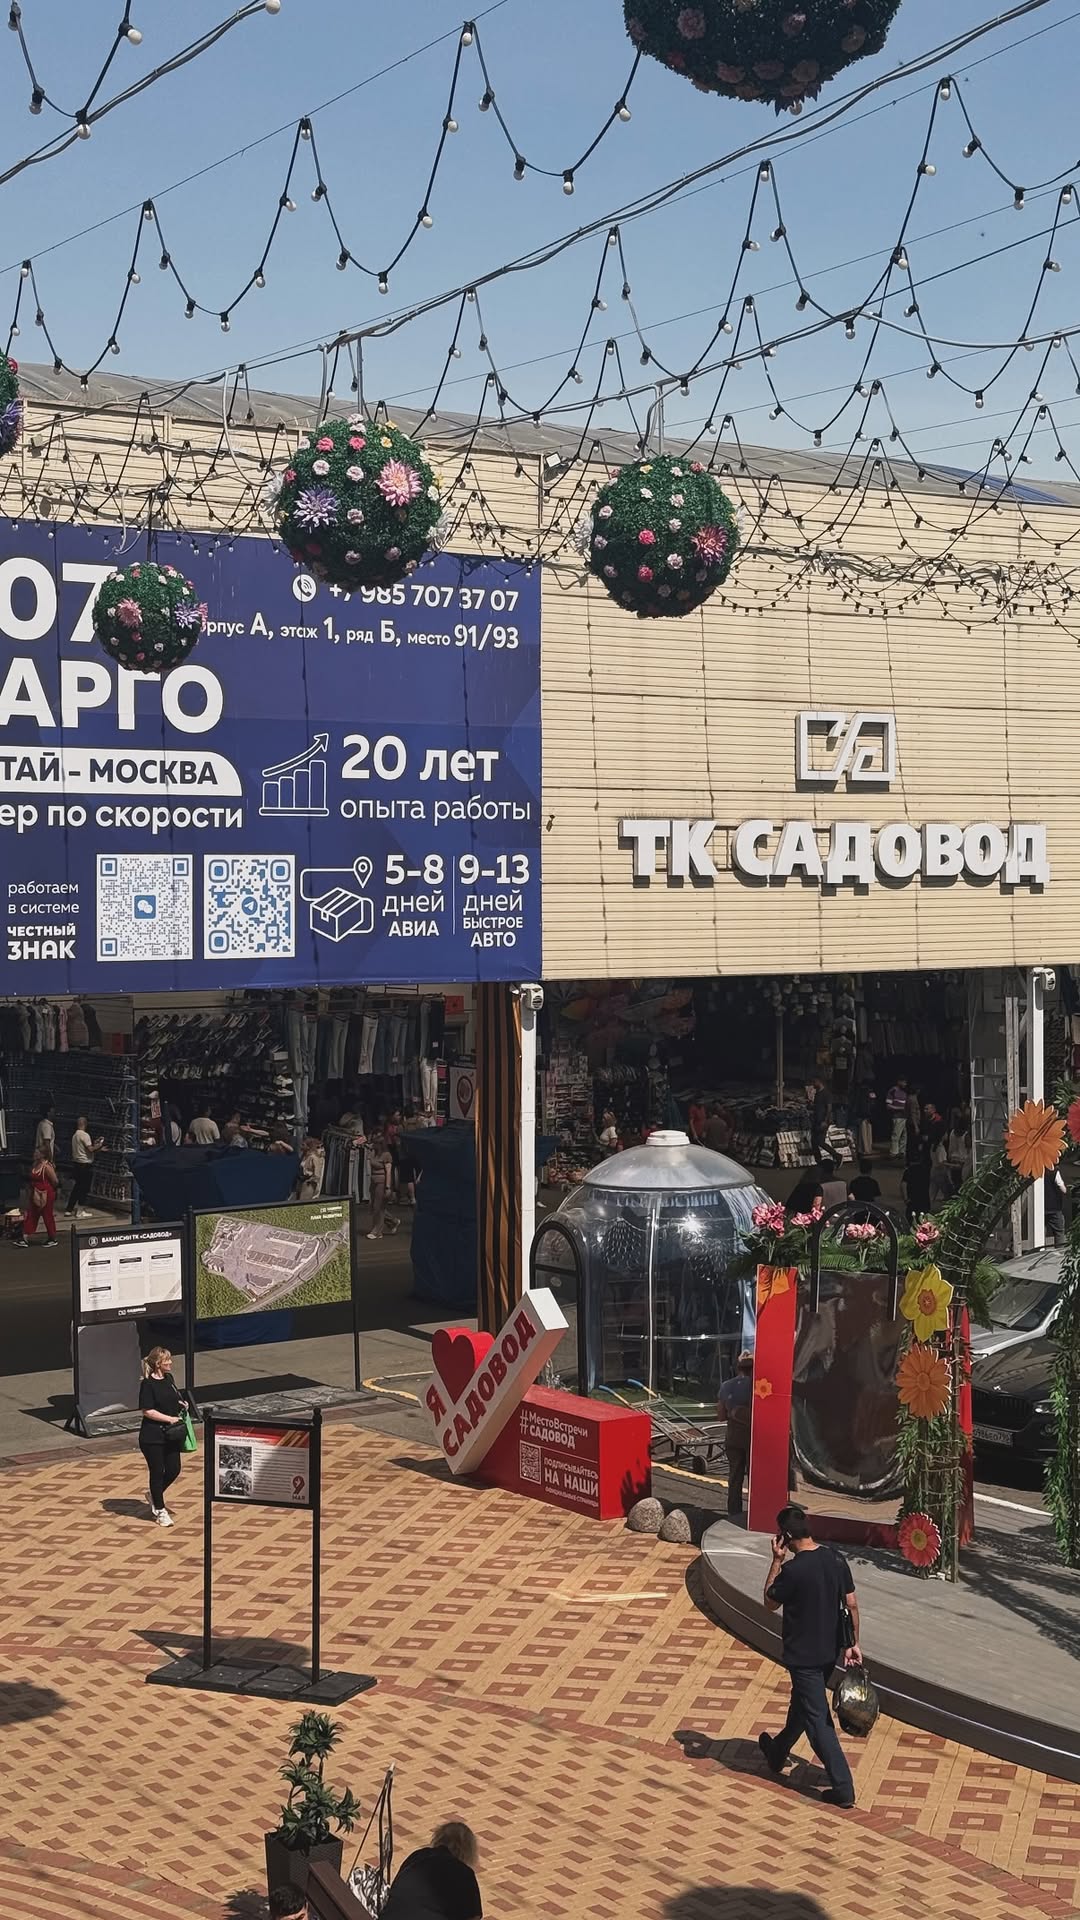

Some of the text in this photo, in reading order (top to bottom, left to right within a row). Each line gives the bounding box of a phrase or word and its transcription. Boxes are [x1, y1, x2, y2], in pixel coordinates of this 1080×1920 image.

[411, 584, 454, 608] 707
[459, 588, 486, 610] 37
[490, 589, 519, 612] 07
[249, 612, 274, 640] А,
[280, 626, 318, 639] этаж
[323, 616, 340, 644] 1,
[346, 629, 374, 644] ряд
[380, 620, 401, 647] Б,
[407, 632, 450, 646] место
[454, 623, 519, 651] 91/93
[0, 656, 224, 734] АРГО
[89, 758, 218, 785] МОСКВА
[341, 734, 499, 782] 20 лет
[48, 805, 87, 827] по
[95, 806, 243, 835] скорости
[340, 795, 531, 826] опыта работы
[618, 818, 1051, 885] ТК САДОВОД
[8, 881, 79, 898] работаем
[382, 890, 444, 916] дней
[463, 890, 523, 915] дней
[8, 903, 80, 914] в системе
[388, 920, 440, 937] АВИА
[463, 917, 523, 929] БЫСТРОЕ
[7, 939, 76, 960] ЗНАК
[470, 931, 516, 948] АВТО
[442, 1310, 536, 1457] САДОВОД
[425, 1383, 447, 1427] Я
[544, 1467, 599, 1497] НА НАШИ
